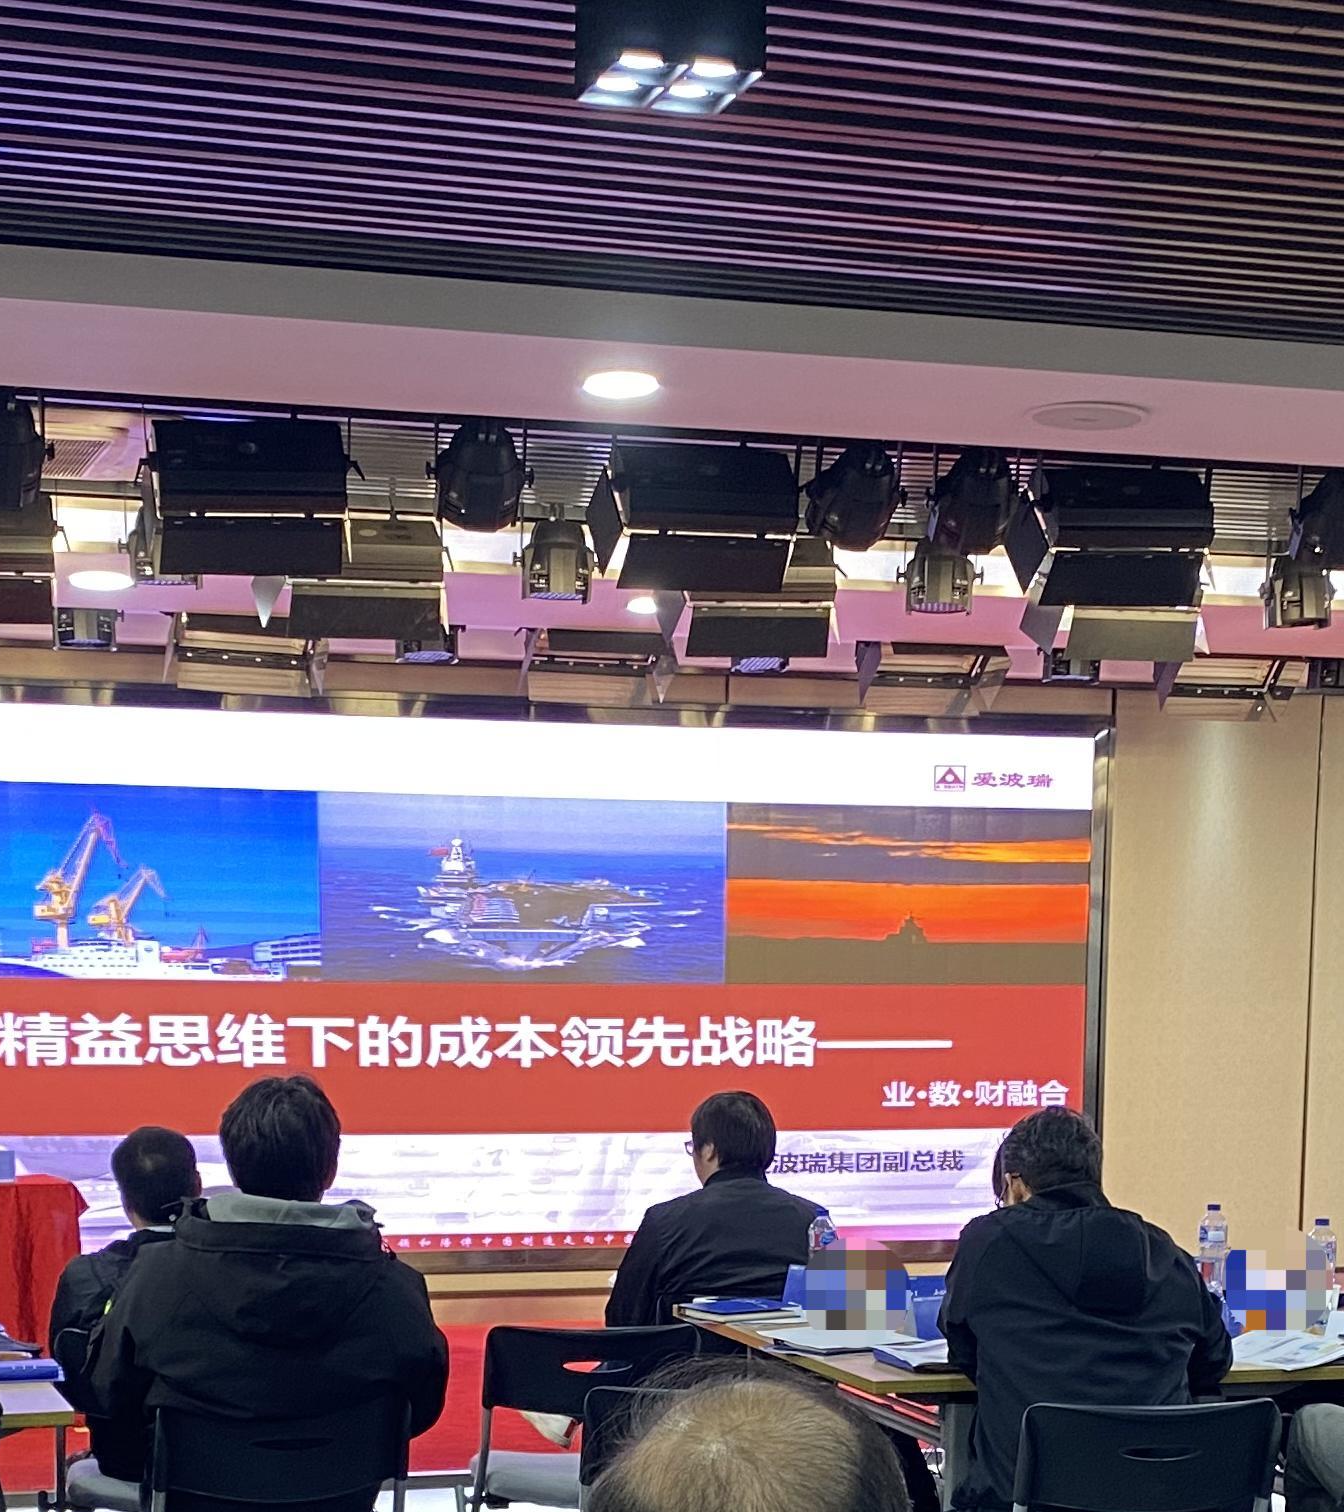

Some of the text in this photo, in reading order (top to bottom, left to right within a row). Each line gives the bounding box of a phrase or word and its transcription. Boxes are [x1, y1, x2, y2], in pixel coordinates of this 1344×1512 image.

[972, 772, 1053, 788] 爱波瑞
[764, 1150, 965, 1174] 波瑞集团副总裁
